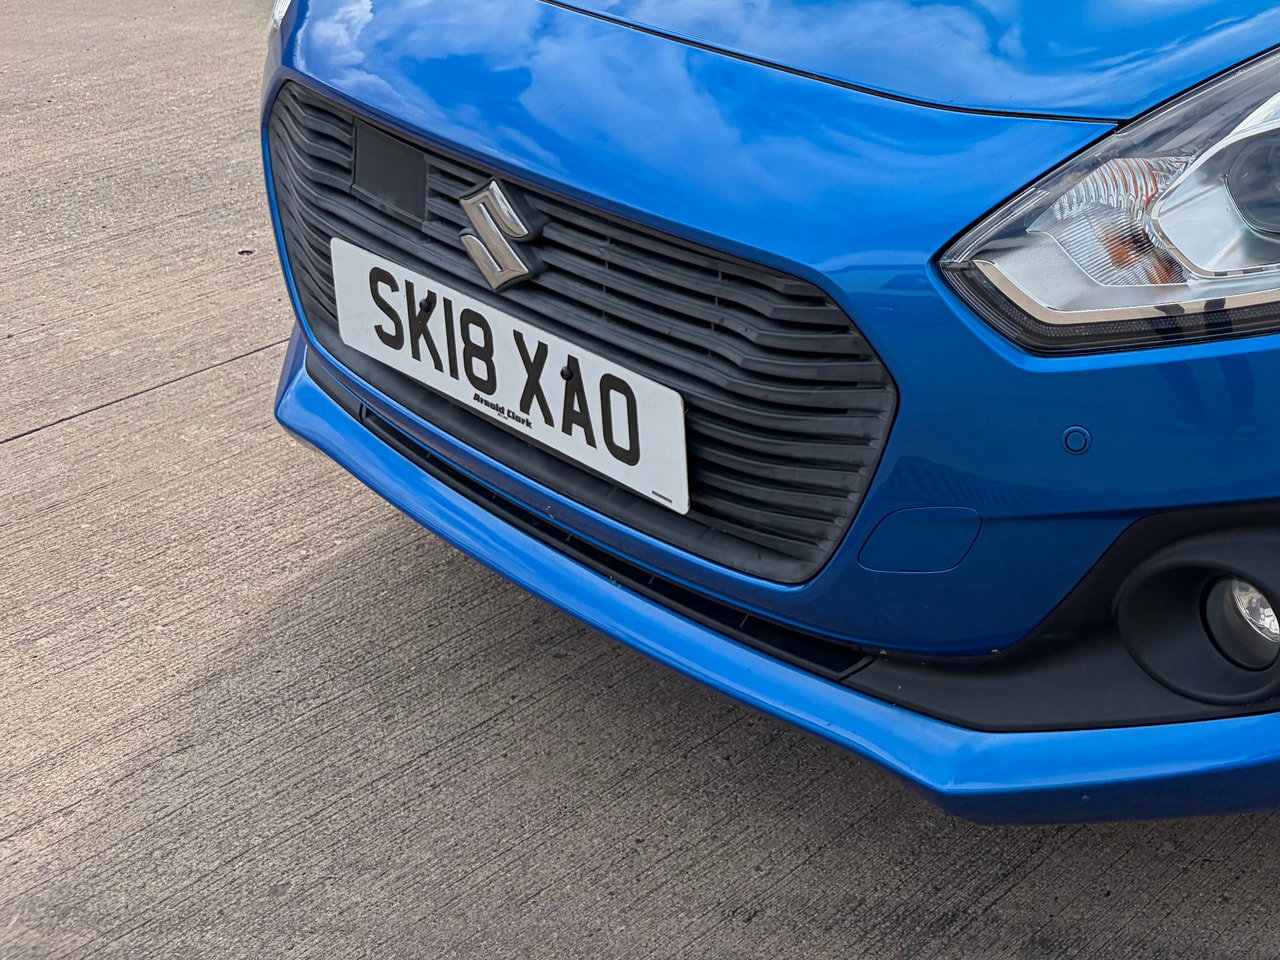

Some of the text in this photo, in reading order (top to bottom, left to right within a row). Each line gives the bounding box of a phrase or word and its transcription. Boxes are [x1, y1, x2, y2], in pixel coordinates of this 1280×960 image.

[369, 266, 641, 466] SK18 XAO
[473, 392, 506, 415] Arnold
[507, 409, 533, 429] Clark
